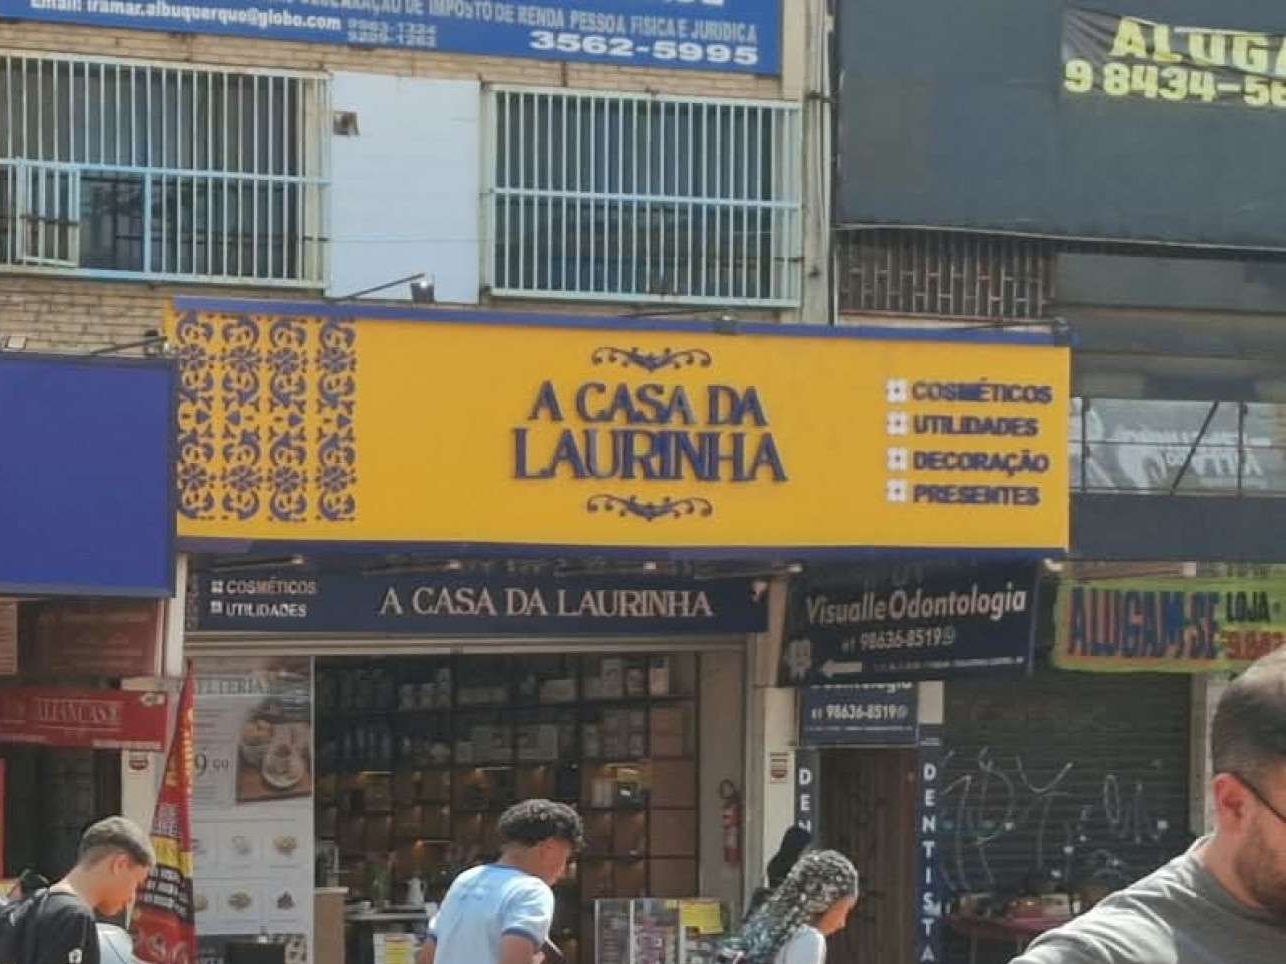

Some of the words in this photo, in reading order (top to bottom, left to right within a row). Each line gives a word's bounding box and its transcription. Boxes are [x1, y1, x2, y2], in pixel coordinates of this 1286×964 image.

[429, 0, 492, 22] IMPOSTO
[495, 4, 515, 23] DE
[517, 6, 564, 27] RENDA
[570, 10, 626, 34] PESSOA
[529, 30, 760, 66] 3562-5995
[526, 380, 564, 422] A
[574, 382, 696, 426] CASA
[706, 385, 769, 427] DA
[912, 377, 1054, 405] COSMÉTICOS
[913, 415, 1040, 438] UTILIDADES
[510, 427, 790, 482] LAURINHA
[912, 449, 1051, 478] DECORAÇÃO
[913, 484, 1041, 506] PRESENTES
[225, 575, 318, 595] COSMÉTICOS
[225, 602, 308, 618] UTILIDADES
[379, 587, 403, 616] A
[412, 586, 498, 617] CASA
[505, 588, 549, 617] DA
[556, 588, 714, 618] LAURINHA
[1226, 591, 1272, 624] LOJA
[921, 762, 937, 963] DENTISTA
